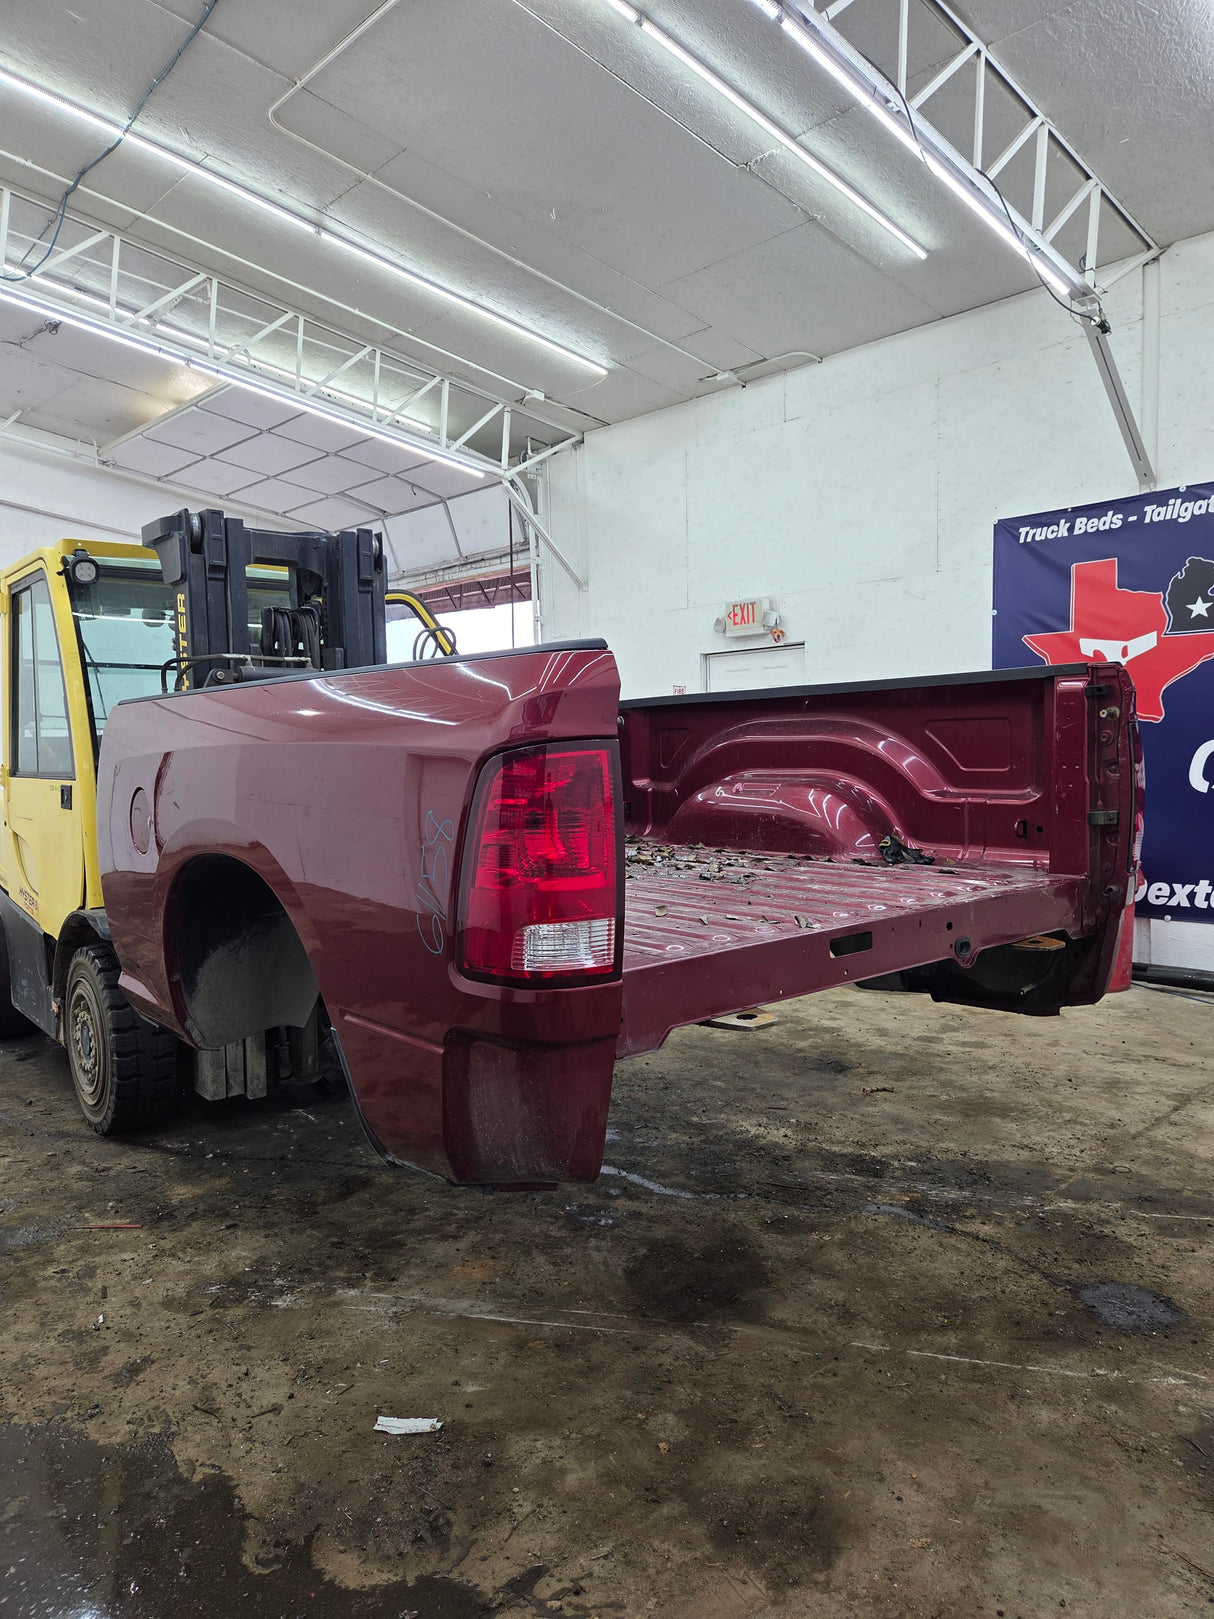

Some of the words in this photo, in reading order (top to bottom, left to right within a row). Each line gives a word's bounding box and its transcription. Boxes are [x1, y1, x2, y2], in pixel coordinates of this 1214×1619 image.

[1019, 519, 1071, 543] Truck
[1073, 510, 1124, 535] Beds
[1144, 495, 1214, 523] Tailgat
[732, 601, 757, 626] EXIT
[177, 593, 190, 691] YSTER
[1135, 879, 1214, 909] ext
